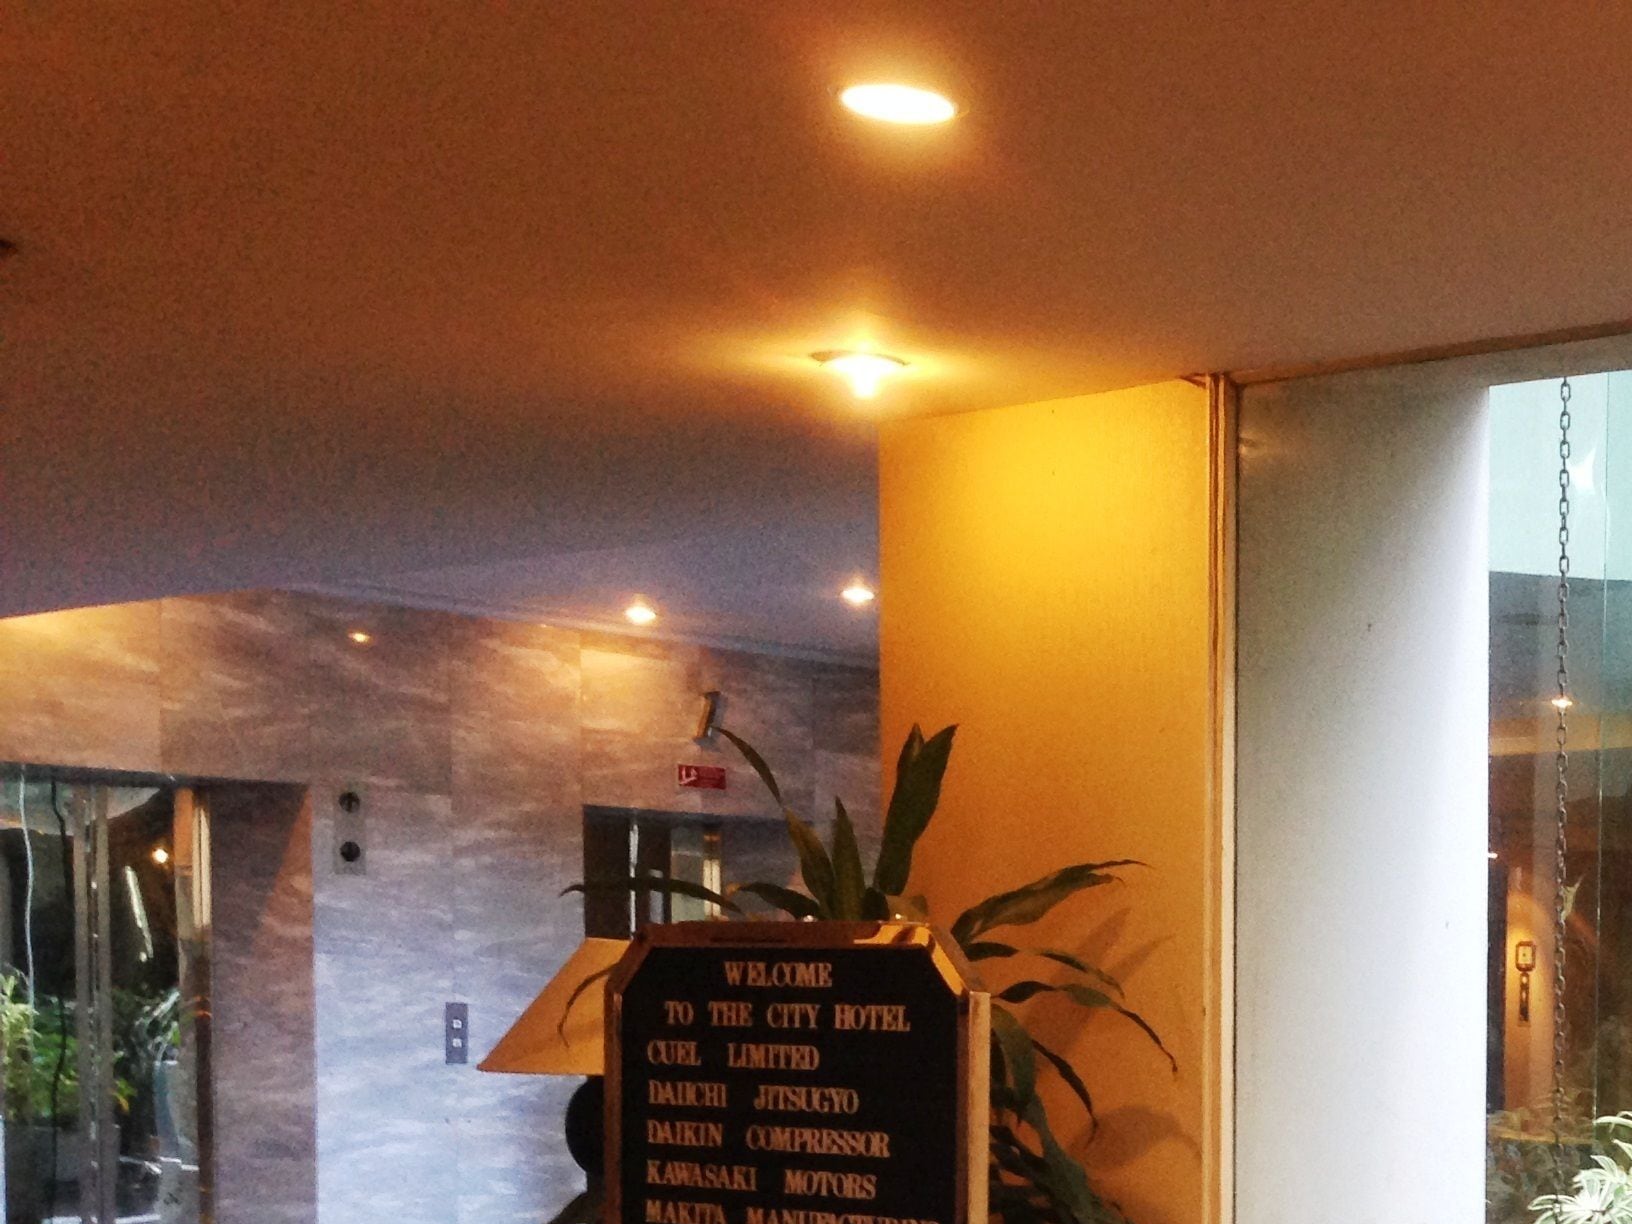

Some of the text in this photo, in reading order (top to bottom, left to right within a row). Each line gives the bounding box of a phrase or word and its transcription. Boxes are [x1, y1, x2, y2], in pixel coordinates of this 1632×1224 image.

[724, 961, 832, 988] WELCOME
[664, 1001, 911, 1032] TO THE CITY HOTEL
[646, 1040, 820, 1071] CUEL LIMITED
[646, 1119, 890, 1159] DAIKIN COMPRESSOR
[646, 1160, 877, 1199] KAWASAKI MOTORS
